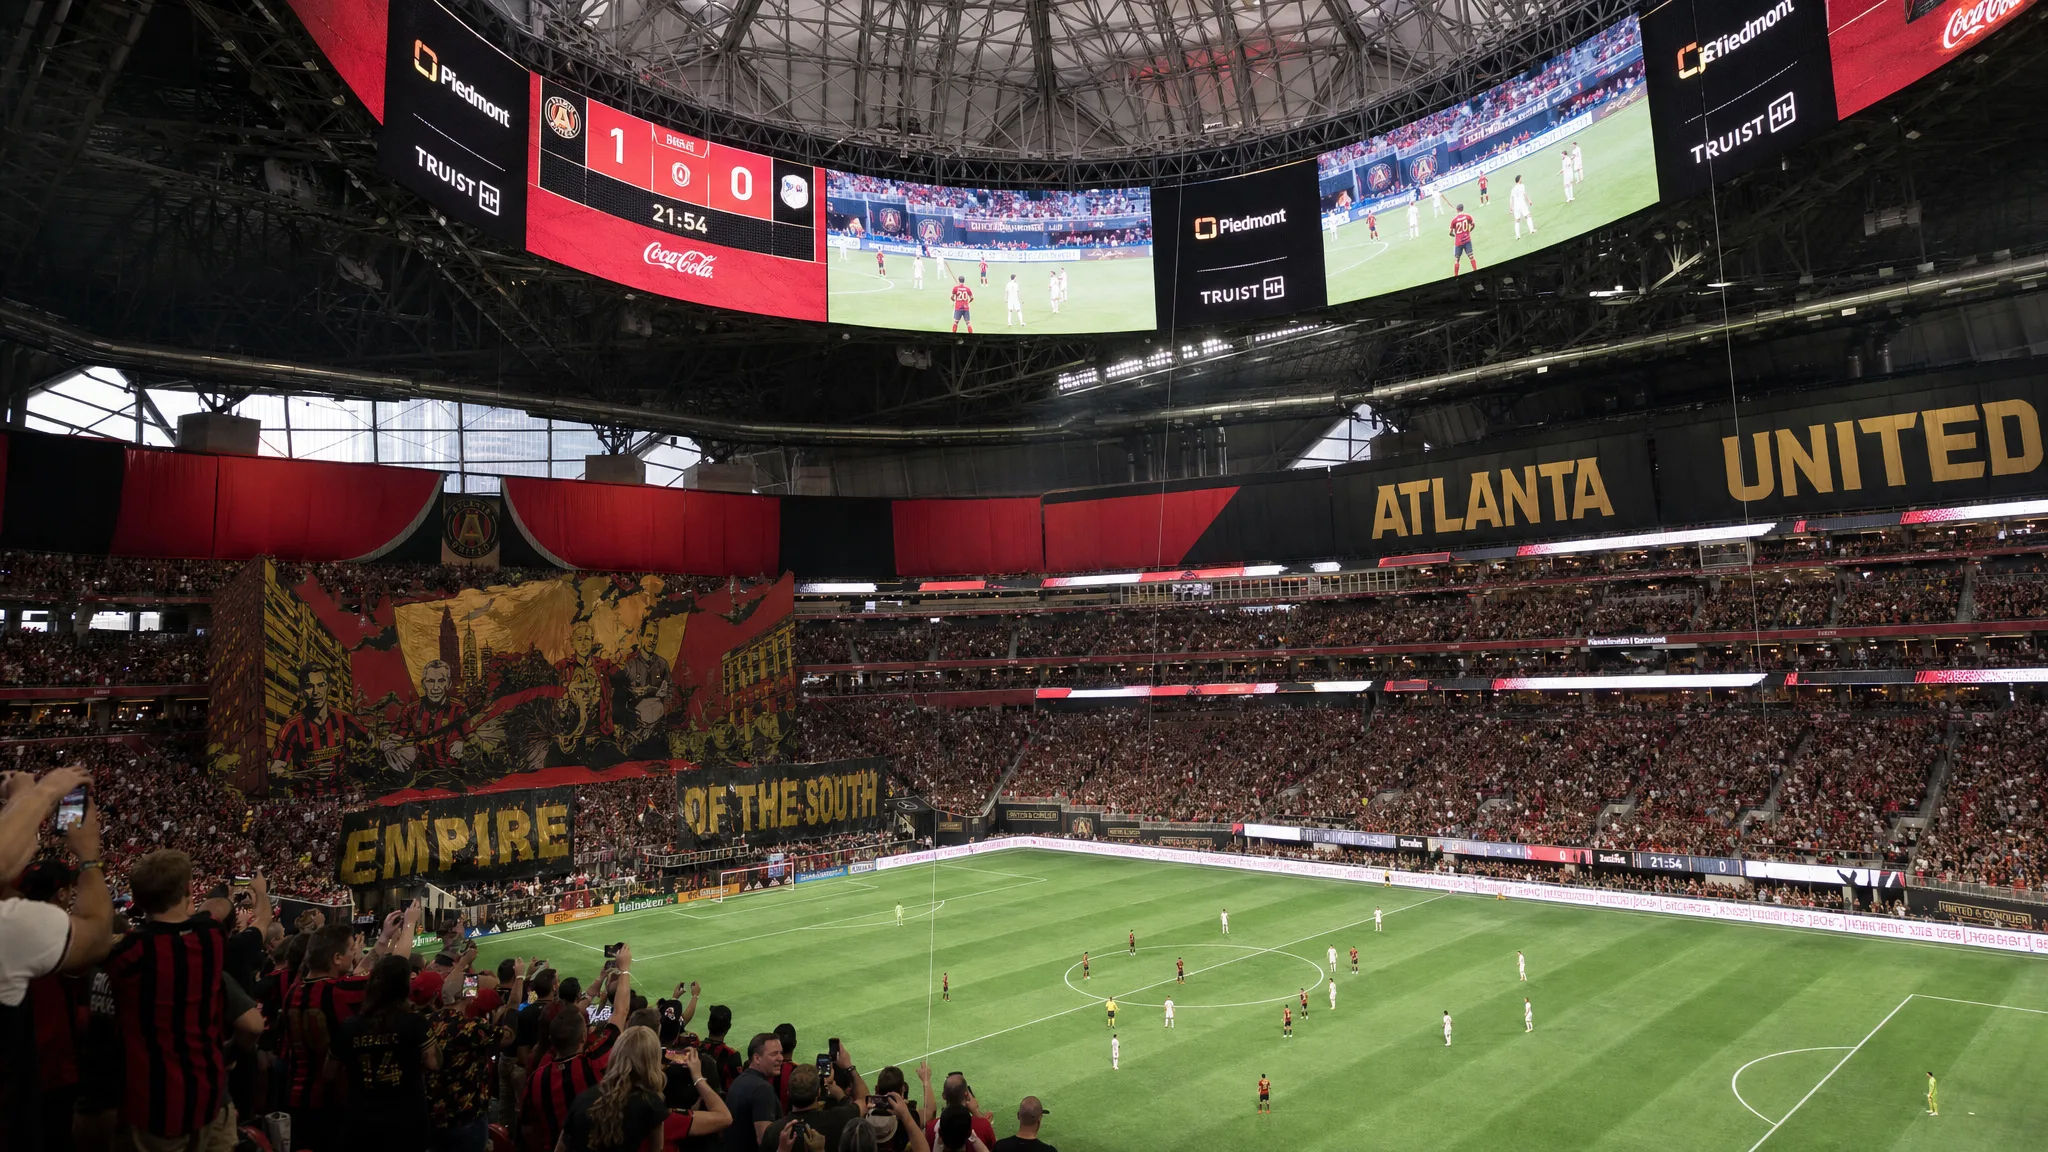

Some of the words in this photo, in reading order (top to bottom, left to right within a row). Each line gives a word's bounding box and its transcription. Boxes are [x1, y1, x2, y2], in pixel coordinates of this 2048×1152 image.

[441, 65, 510, 128] Piedmont
[610, 127, 624, 164] 1
[1690, 114, 1765, 164] TRUIST
[415, 145, 476, 197] TRUIST
[731, 166, 753, 201] 0
[652, 203, 708, 234] 21:54
[1220, 208, 1286, 234] Piedmont
[1455, 219, 1468, 234] 20
[643, 241, 718, 279] Coca-Cola
[956, 290, 968, 301] 20
[1200, 284, 1260, 305] TRUIST
[1371, 457, 1615, 540] ATLANTA
[1722, 398, 2044, 502] UNITED
[684, 783, 727, 835] OF
[735, 777, 799, 832] THE
[805, 769, 878, 826] SOUTH
[340, 803, 569, 885] EMPIRE
[1650, 856, 1683, 869] 21:54
[618, 898, 664, 913] Heineken
